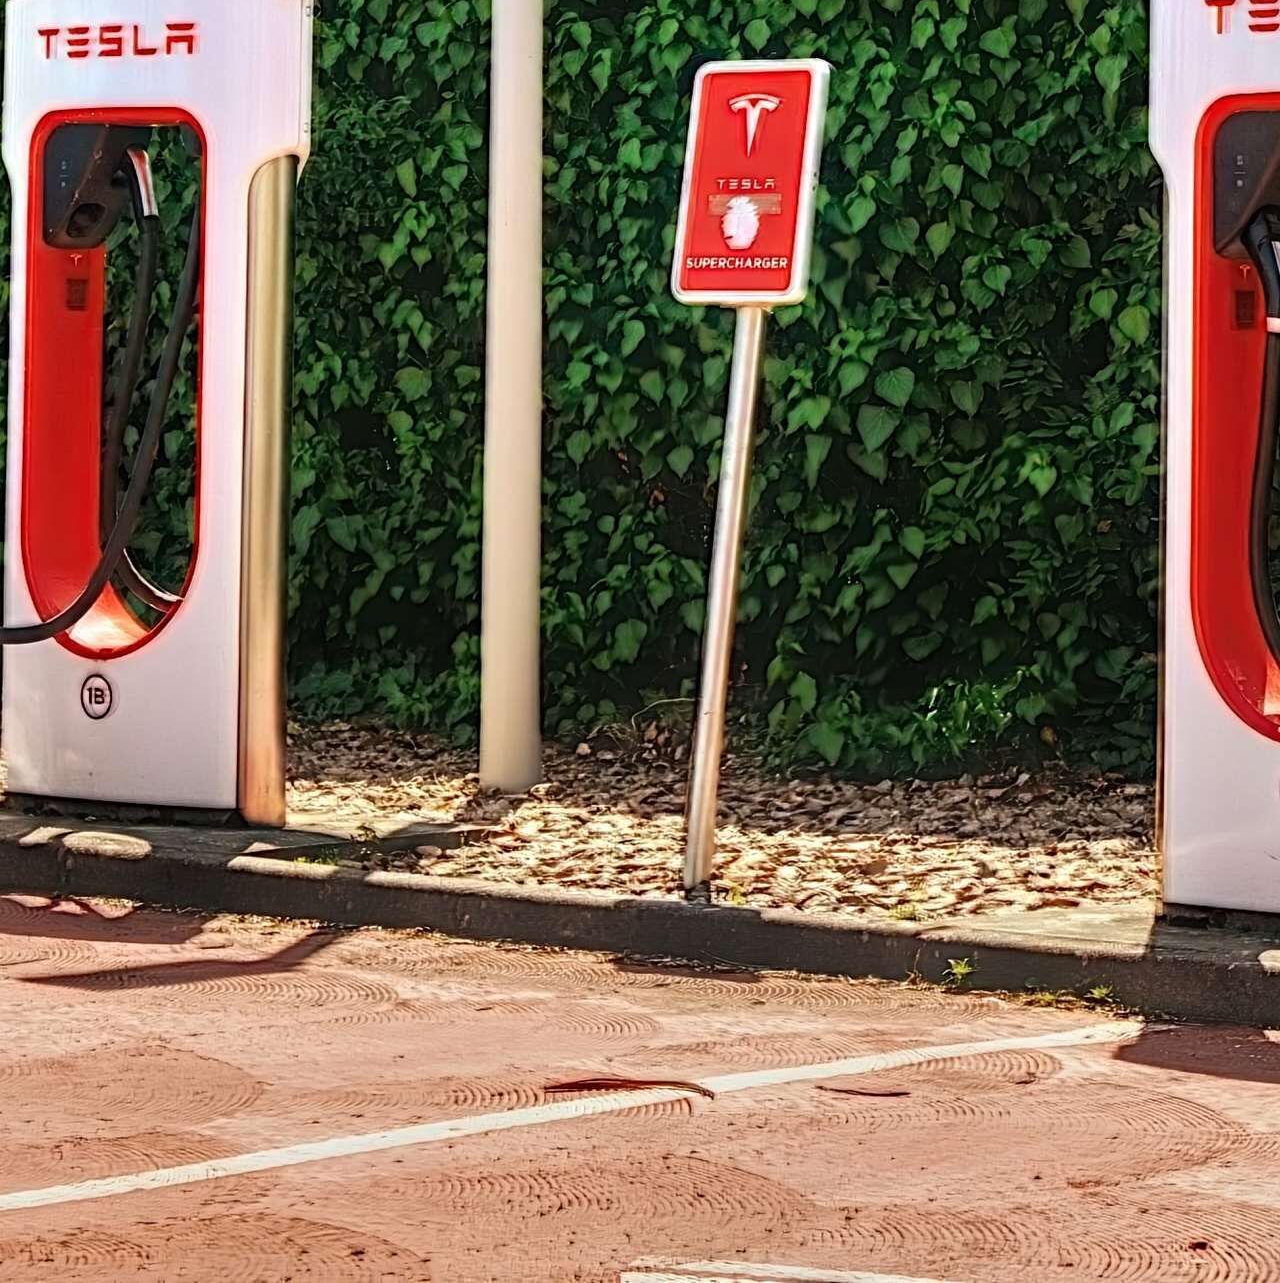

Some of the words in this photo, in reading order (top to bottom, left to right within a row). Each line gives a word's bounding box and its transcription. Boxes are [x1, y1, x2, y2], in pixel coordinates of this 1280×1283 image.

[38, 22, 196, 59] TESLA
[716, 178, 776, 190] TESLA
[686, 256, 788, 270] SUPERCHARGER
[87, 687, 106, 705] 1B
